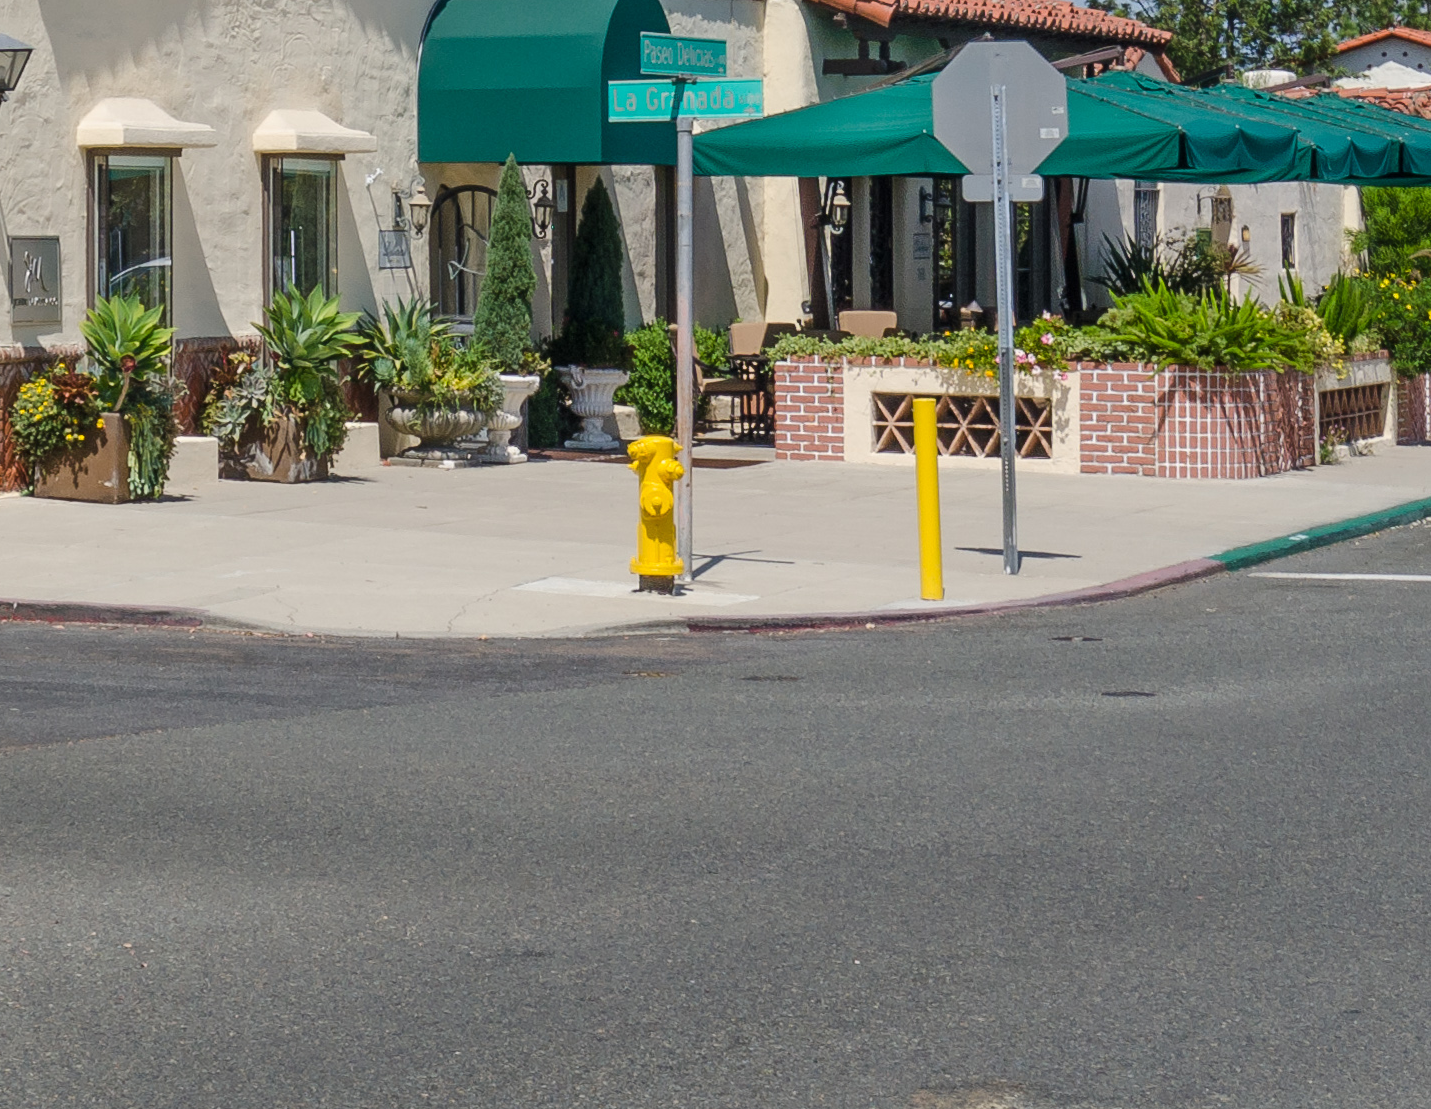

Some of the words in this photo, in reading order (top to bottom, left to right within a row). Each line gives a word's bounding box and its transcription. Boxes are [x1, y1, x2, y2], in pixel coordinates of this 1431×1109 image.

[644, 39, 674, 65] Paseo
[677, 42, 715, 68] Delicias
[613, 88, 636, 112] La
